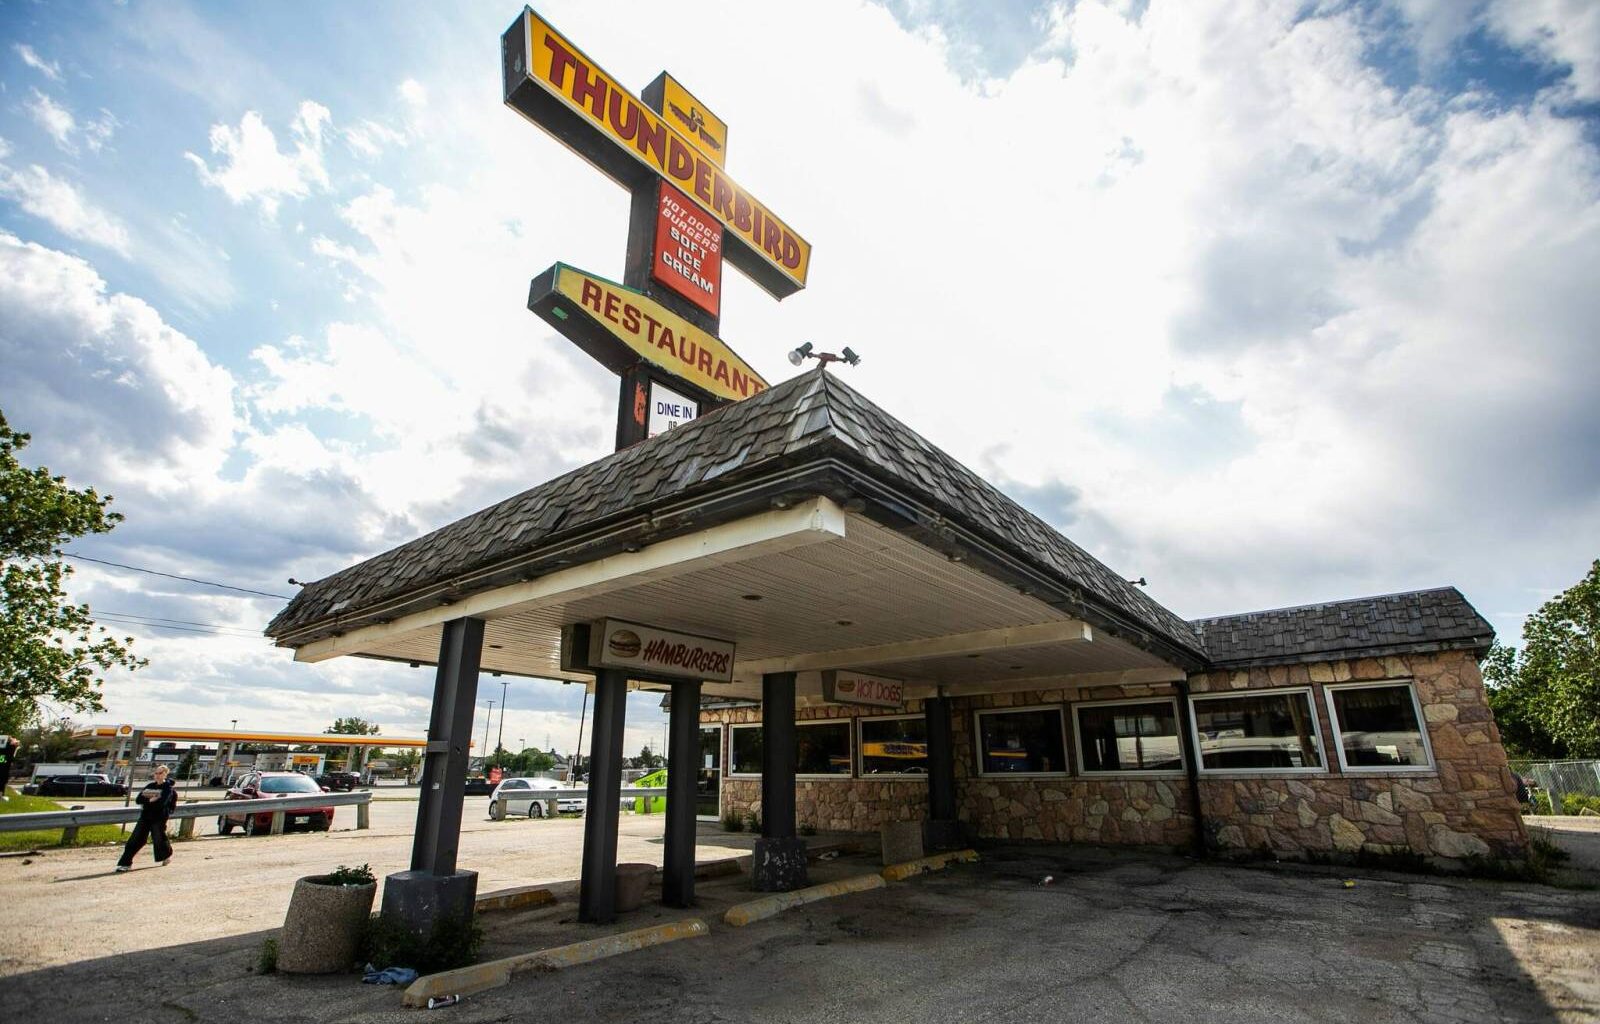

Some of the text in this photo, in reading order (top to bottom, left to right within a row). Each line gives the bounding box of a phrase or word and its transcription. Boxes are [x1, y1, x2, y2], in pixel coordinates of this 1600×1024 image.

[544, 33, 801, 269] THUNDERBIRD
[662, 195, 720, 243] HOT DOGS
[662, 208, 719, 253] BURGERS
[670, 226, 708, 260] SOFT
[677, 246, 701, 273] ICE
[663, 251, 714, 295] CREAM
[581, 278, 764, 397] RESTAURANT
[657, 402, 692, 420] DINE IN
[642, 639, 730, 674] HAMBURGERS
[857, 678, 902, 702] HOT DOGS
